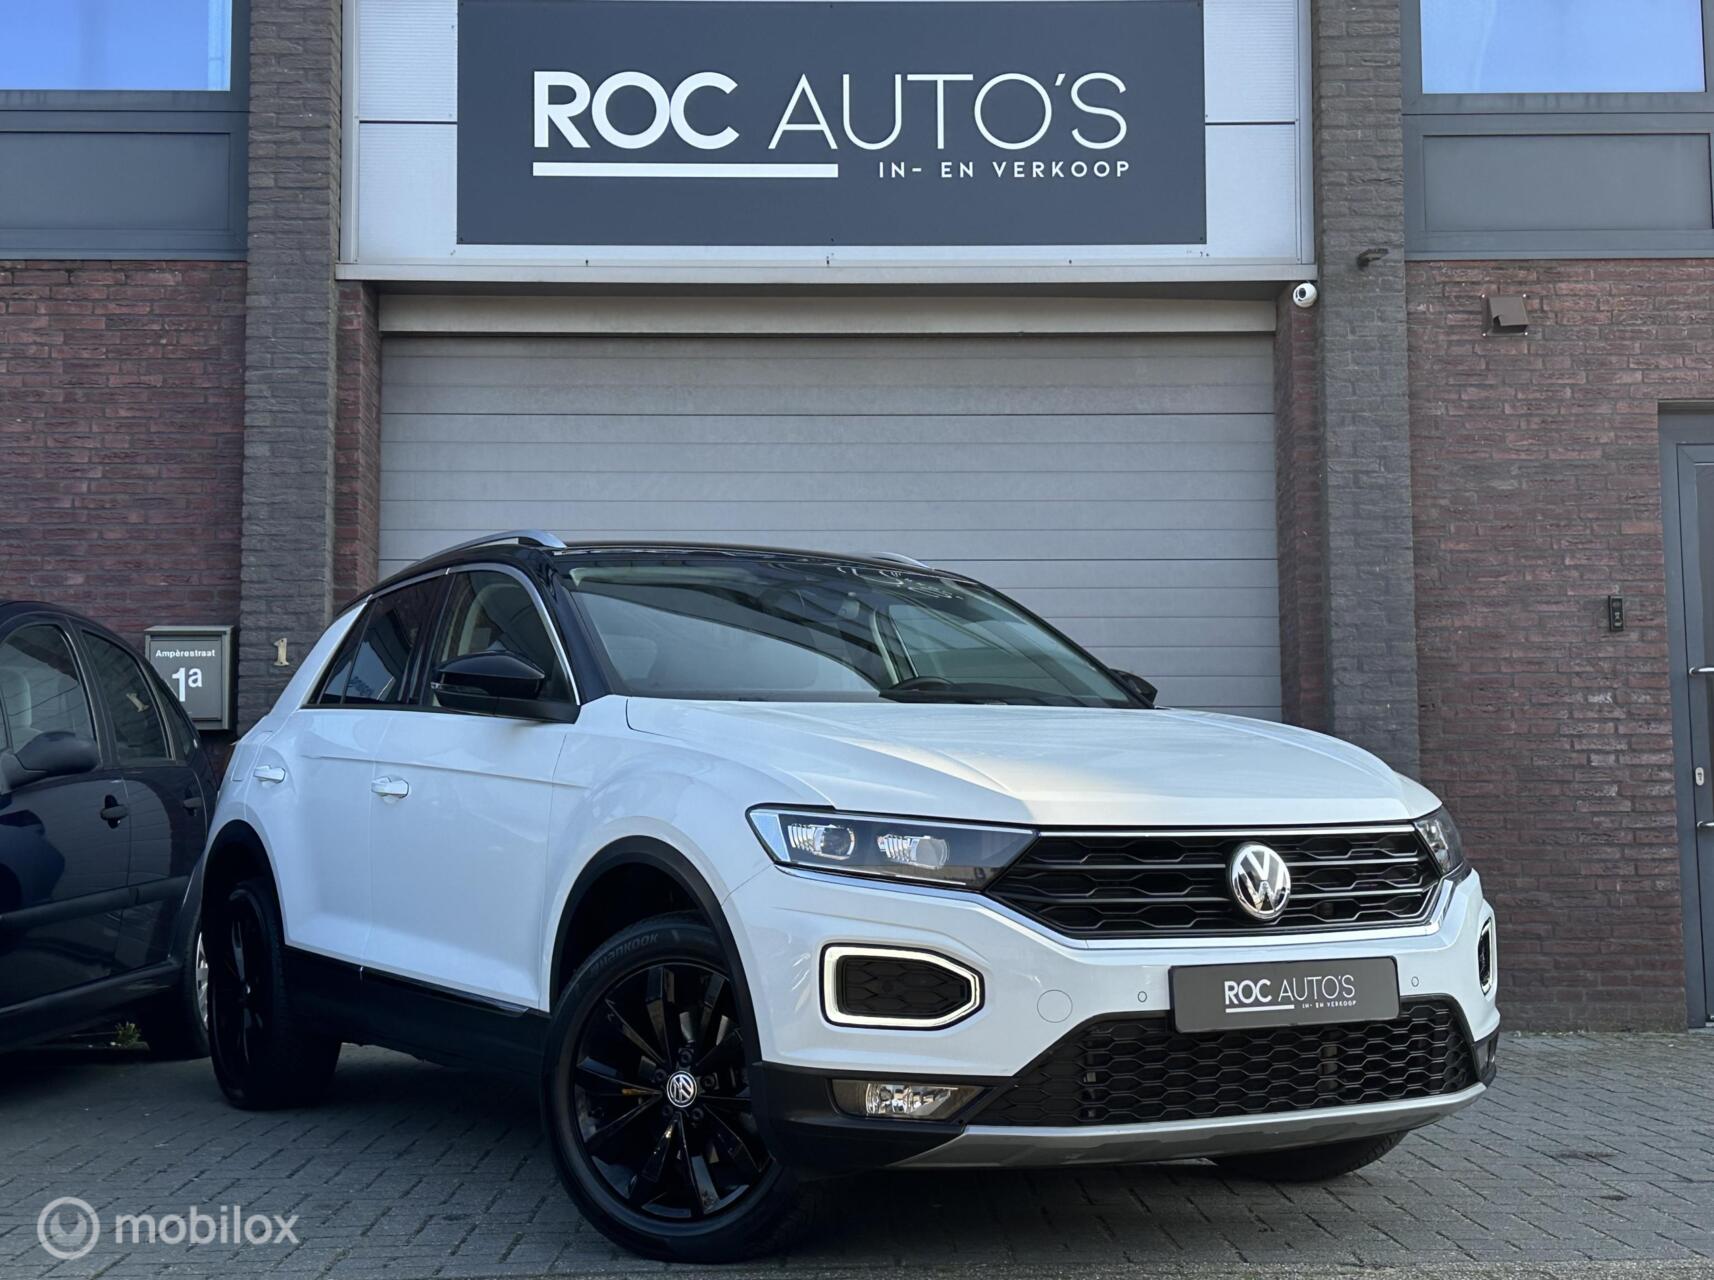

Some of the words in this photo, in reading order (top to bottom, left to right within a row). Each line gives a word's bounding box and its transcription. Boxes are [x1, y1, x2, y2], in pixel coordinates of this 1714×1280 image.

[533, 71, 740, 149] ROC
[769, 72, 1128, 150] AUTO'S
[879, 161, 922, 178] IN-
[942, 161, 974, 178] EN
[993, 160, 1130, 178] VERKOOP
[273, 637, 290, 667] 1
[171, 667, 203, 702] 1a
[1224, 978, 1273, 1005] ROC
[1278, 974, 1357, 1002] AUTO'S
